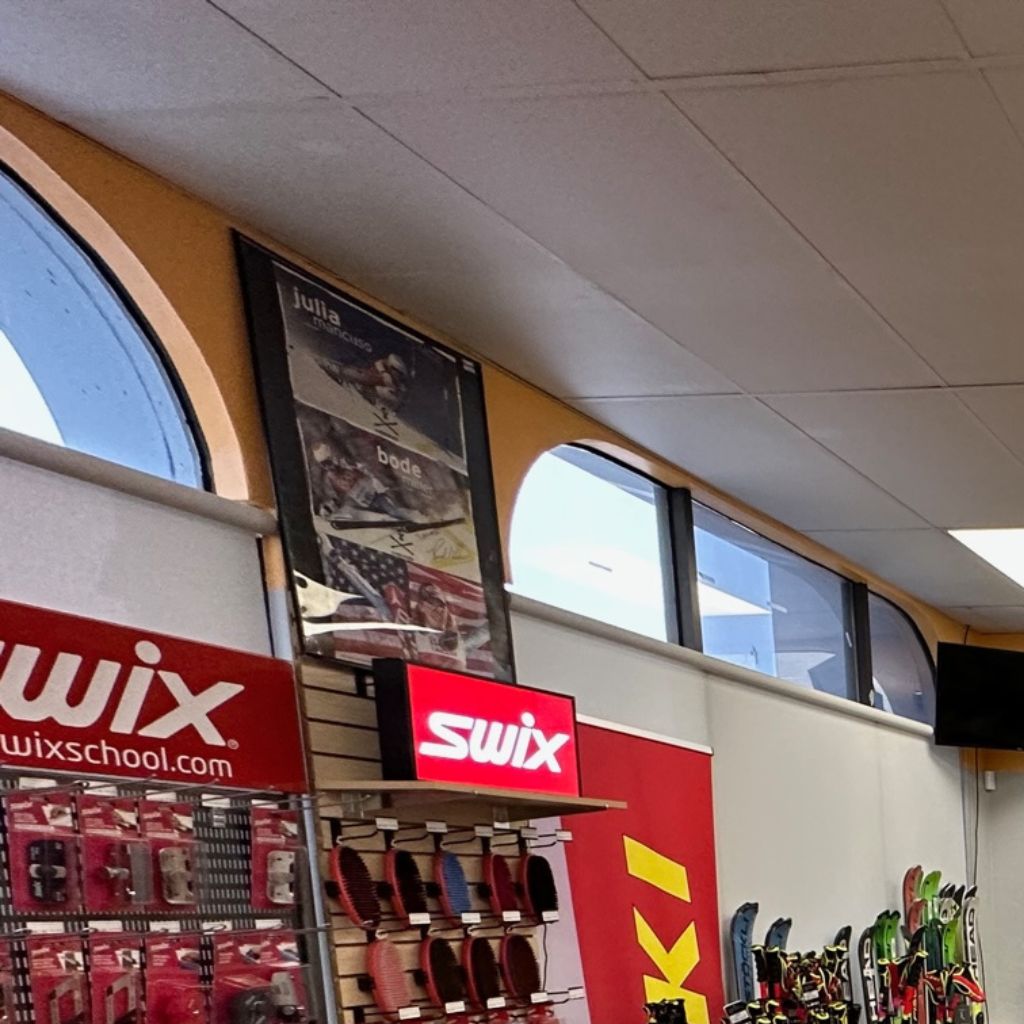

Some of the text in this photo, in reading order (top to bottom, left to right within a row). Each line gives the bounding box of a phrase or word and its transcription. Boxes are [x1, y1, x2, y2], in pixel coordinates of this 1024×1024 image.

[293, 286, 341, 326] julia
[377, 445, 422, 479] bode
[0, 640, 245, 747] wix
